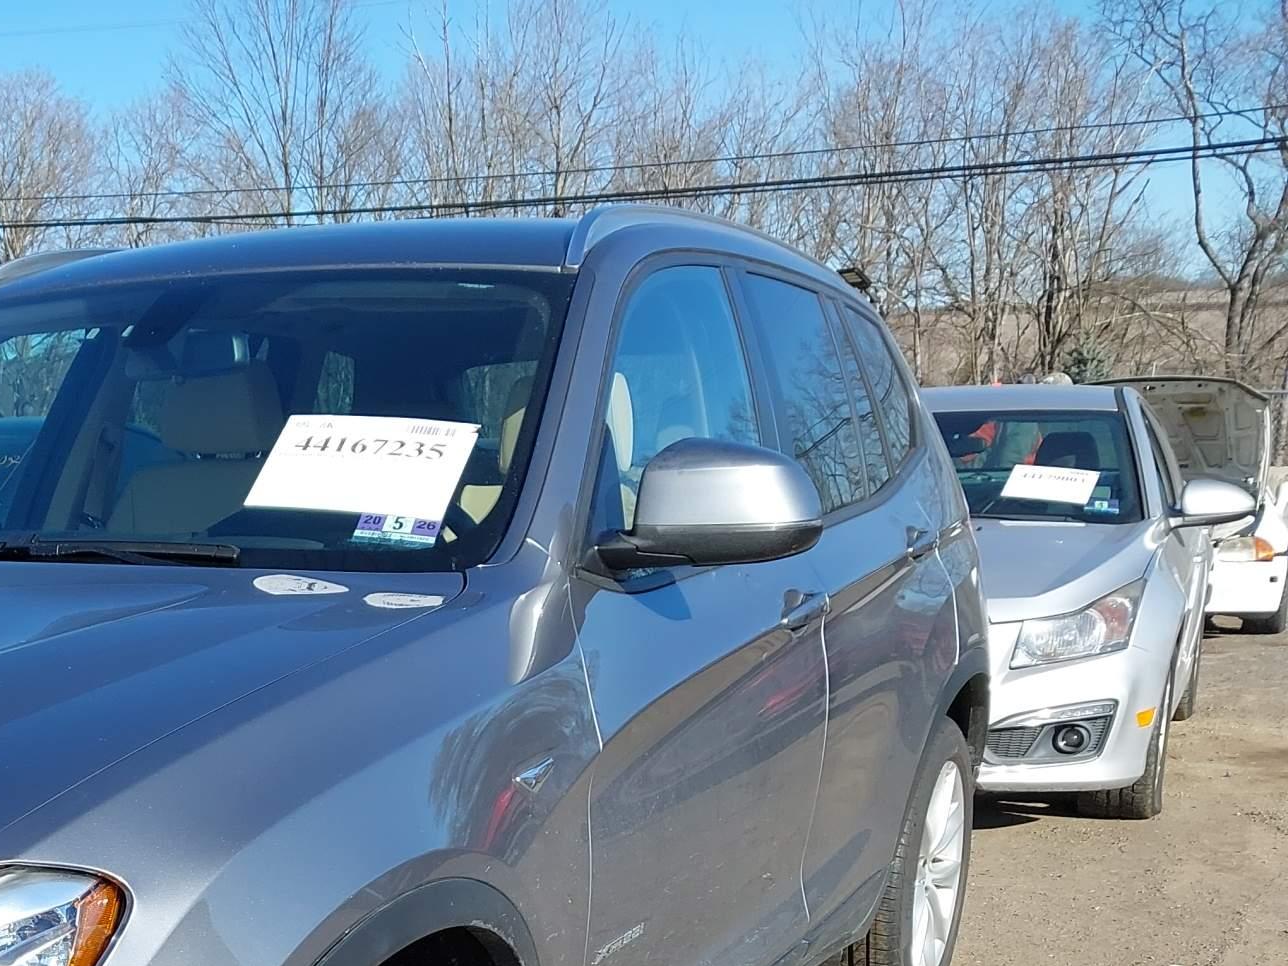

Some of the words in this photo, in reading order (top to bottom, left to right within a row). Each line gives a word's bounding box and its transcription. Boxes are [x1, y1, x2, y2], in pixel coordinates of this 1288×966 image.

[295, 435, 448, 460] 44167235
[363, 514, 382, 525] 20
[392, 516, 405, 530] 5
[415, 520, 437, 530] 26
